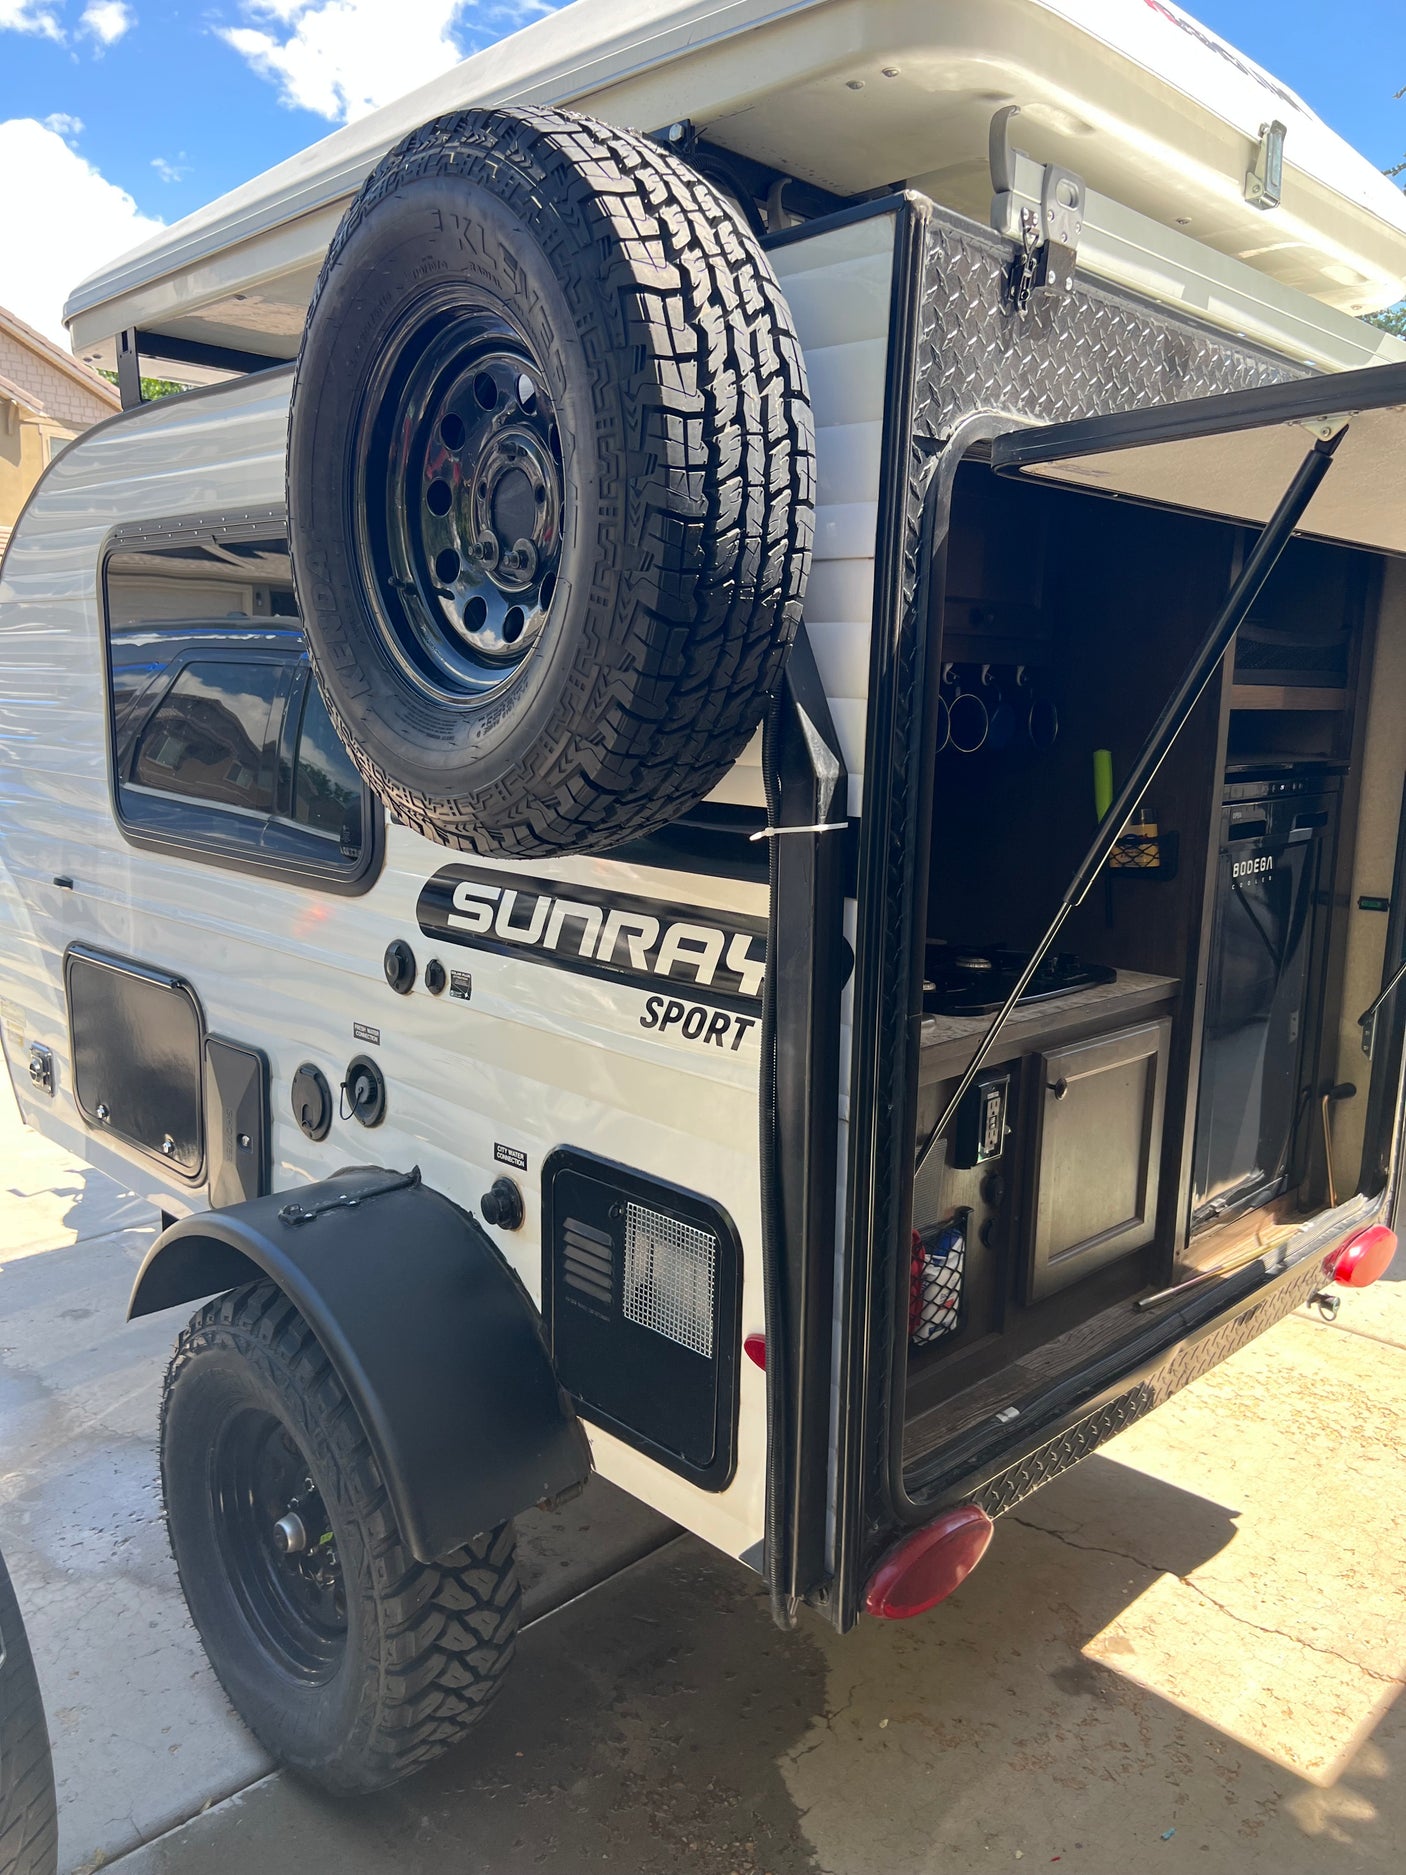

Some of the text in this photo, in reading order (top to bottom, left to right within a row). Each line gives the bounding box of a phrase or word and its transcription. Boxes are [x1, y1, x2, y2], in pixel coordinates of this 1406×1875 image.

[305, 551, 372, 699] KENDA
[1232, 855, 1273, 878] BODEGA
[447, 881, 768, 997] SUNRAY
[639, 996, 756, 1052] SPORT
[496, 1151, 525, 1168] CONNECTION
[497, 1145, 524, 1161] CITY WATER
